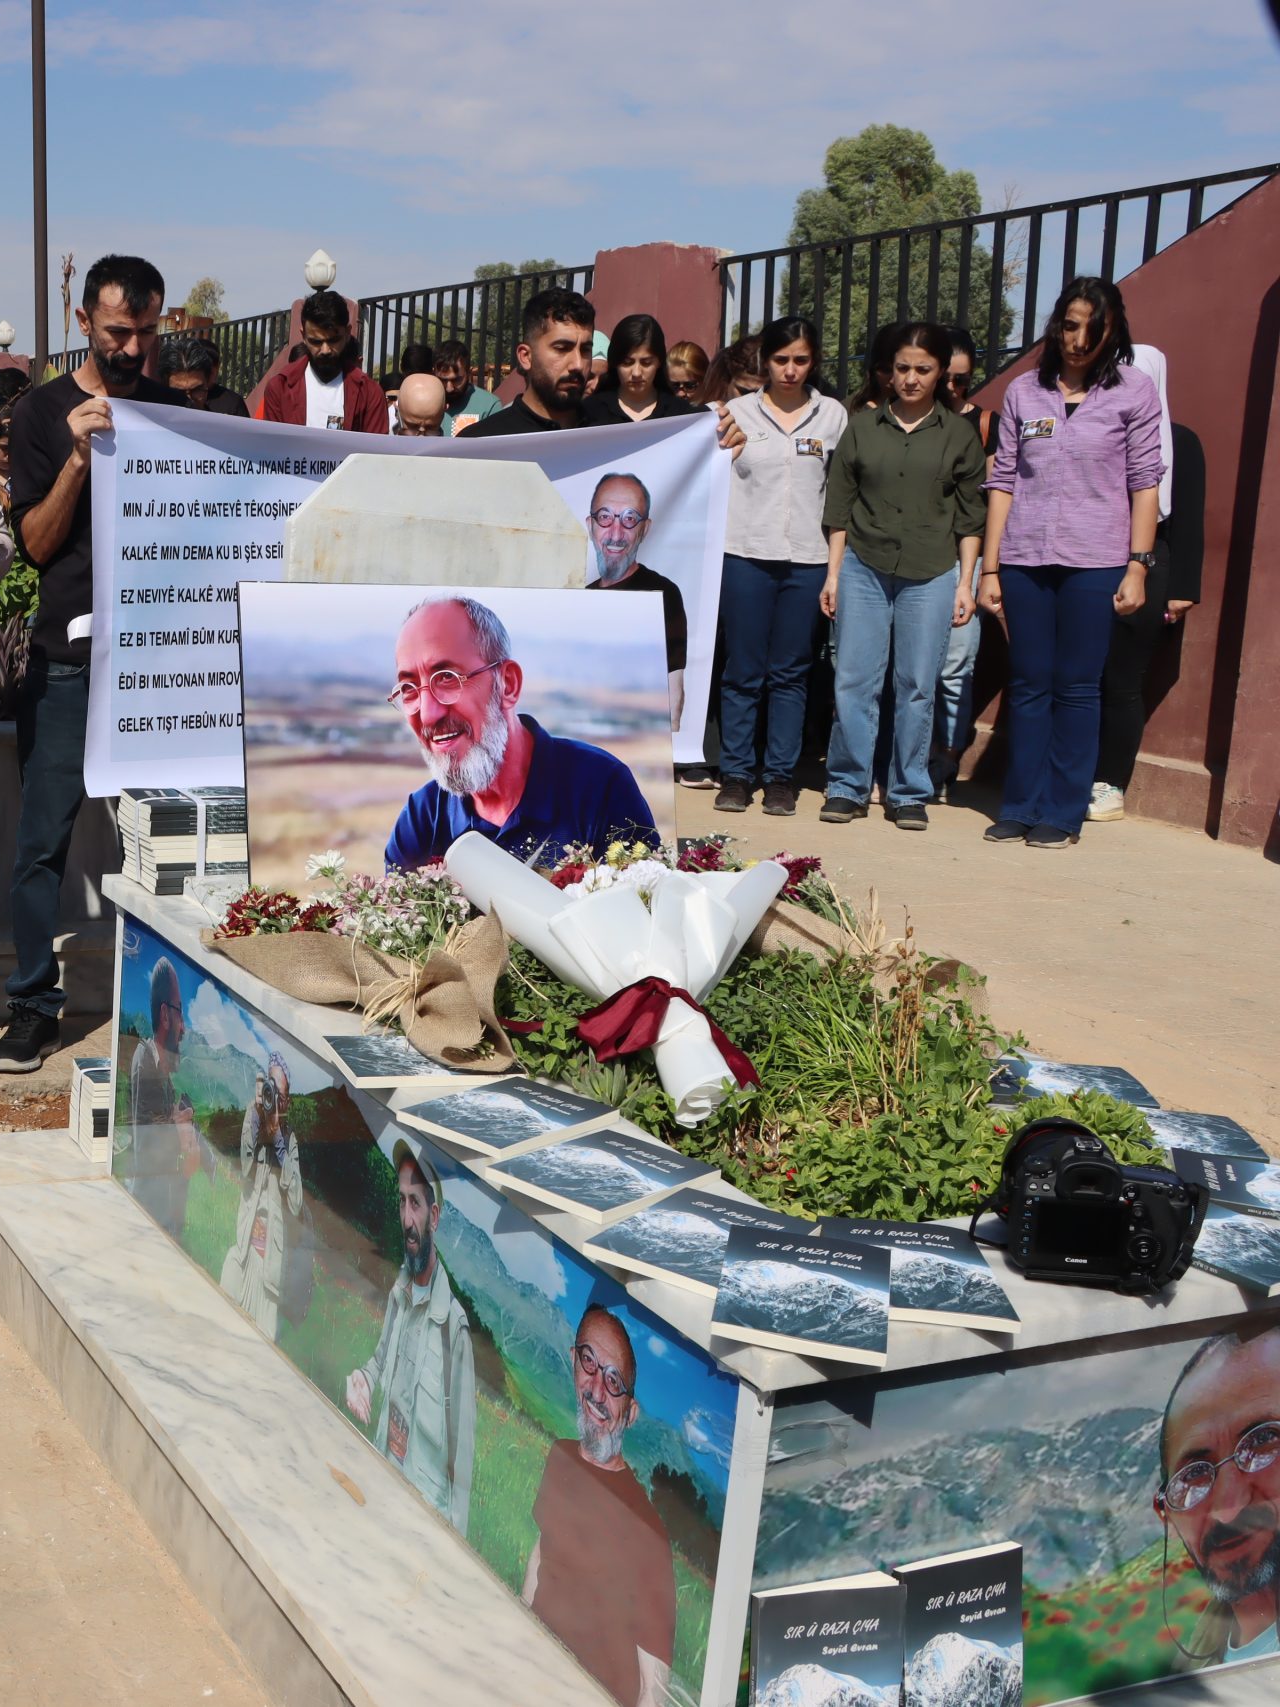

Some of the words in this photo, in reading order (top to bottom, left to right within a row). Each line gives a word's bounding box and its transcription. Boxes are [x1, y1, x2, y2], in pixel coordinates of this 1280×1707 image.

[124, 459, 133, 474] JI
[136, 459, 152, 474] BO
[155, 460, 182, 475] WATE
[185, 460, 193, 475] LI
[196, 460, 216, 475] HER
[219, 456, 254, 475] KÊLIYA
[256, 457, 290, 475] JIYANÊ
[294, 457, 307, 475] BÊ
[310, 460, 336, 475] KIRIN
[123, 502, 142, 517] MIN
[145, 500, 154, 517] JÎ
[157, 502, 167, 517] JI
[169, 502, 185, 517] BO
[188, 500, 200, 517] VÊ
[203, 499, 241, 517] WATEYÊ
[122, 542, 158, 560] KALKÊ
[160, 545, 180, 560] MIN
[183, 545, 213, 560] DEMA
[216, 545, 230, 560] KU
[233, 545, 242, 560] BI
[245, 541, 263, 564] ŞÊX
[265, 541, 284, 559] SEÎ
[120, 589, 134, 604] EZ
[137, 585, 175, 604] NEVIYÊ
[177, 584, 213, 603] KALKÊ
[120, 632, 133, 647] EZ
[136, 632, 146, 647] BI
[149, 627, 190, 646] TEMAMÎ
[192, 626, 215, 645] BÛM
[118, 672, 137, 690] ÊDÎ
[139, 674, 149, 689] BI
[152, 672, 205, 689] MILYONAN
[207, 671, 241, 686] MIROV
[118, 716, 154, 733] GELEK
[157, 715, 178, 734] TIŞT
[181, 711, 216, 730] HEBÛN
[219, 713, 233, 727] KU
[795, 1246, 830, 1256] RAZA
[925, 1595, 944, 1611] SIR
[956, 1587, 983, 1605] RAZA
[784, 1625, 806, 1639] SIR
[819, 1620, 851, 1636] RAZA
